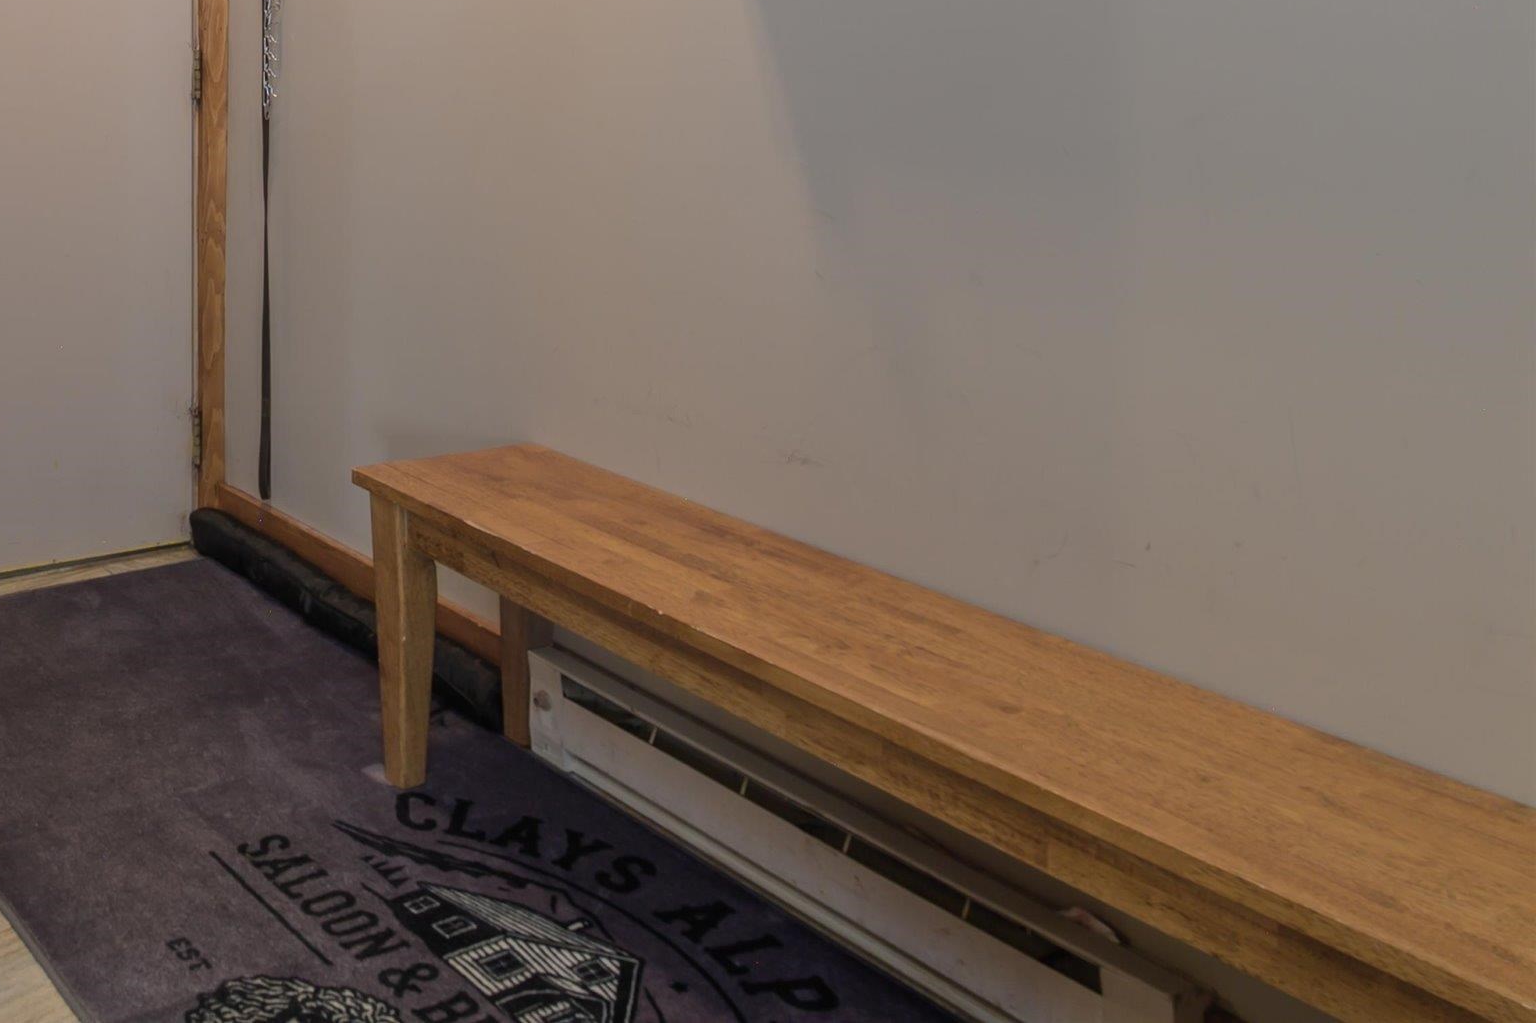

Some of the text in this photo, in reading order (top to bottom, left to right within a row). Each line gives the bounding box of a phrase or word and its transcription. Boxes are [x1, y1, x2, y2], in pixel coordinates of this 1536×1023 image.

[395, 791, 657, 893] CLAYS
[167, 937, 212, 972] EST
[237, 834, 410, 961] SALOON
[378, 963, 439, 998] &
